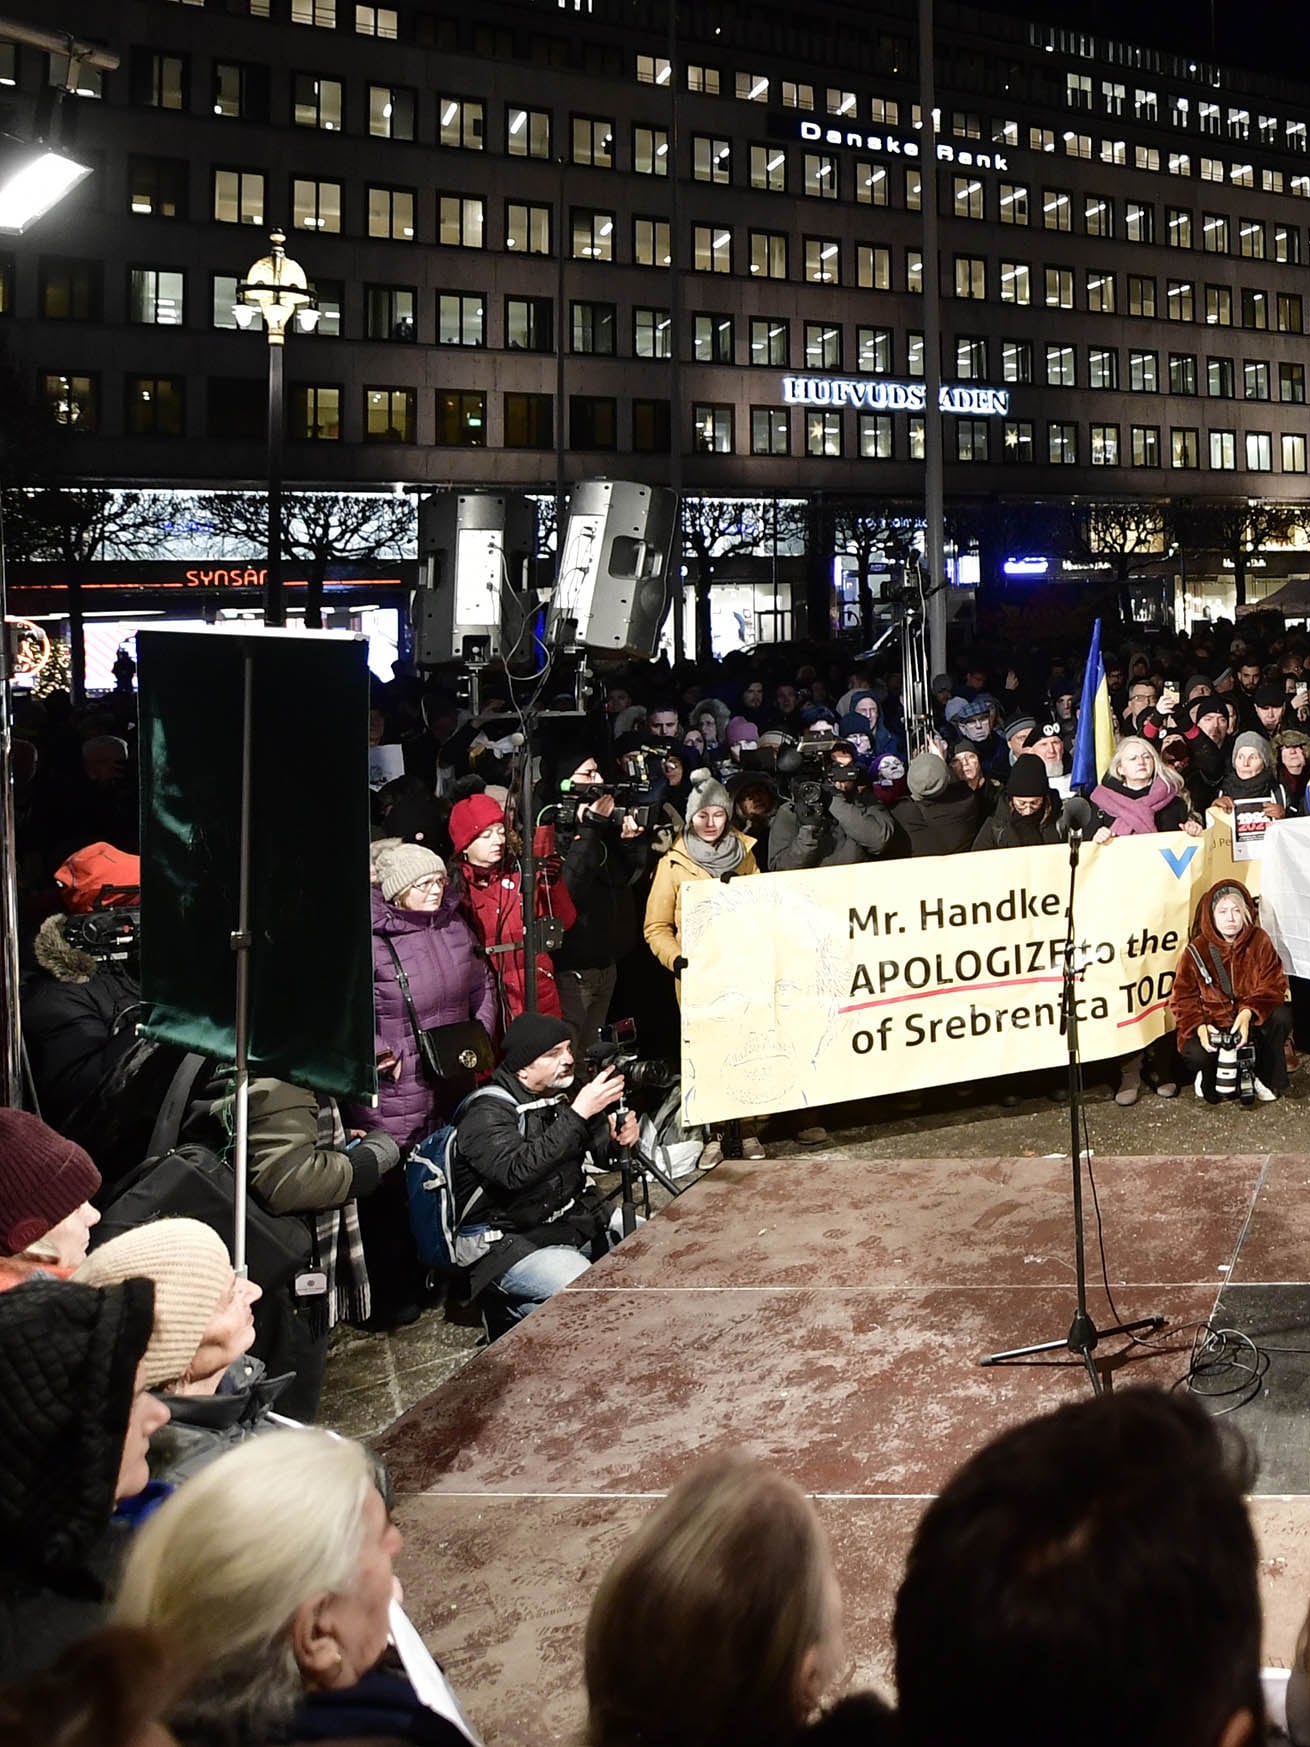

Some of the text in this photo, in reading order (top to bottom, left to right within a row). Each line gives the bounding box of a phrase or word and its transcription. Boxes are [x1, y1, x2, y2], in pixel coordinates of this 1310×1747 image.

[801, 121, 1008, 171] Danske Bank
[783, 376, 1009, 416] HUFVUDSADEN
[848, 905, 906, 939] Mr.
[849, 938, 1068, 998] APOLOGIZE
[1080, 938, 1115, 966] to
[1127, 928, 1178, 959] the
[852, 1017, 893, 1055] of
[906, 992, 1109, 1048] Srebrenica
